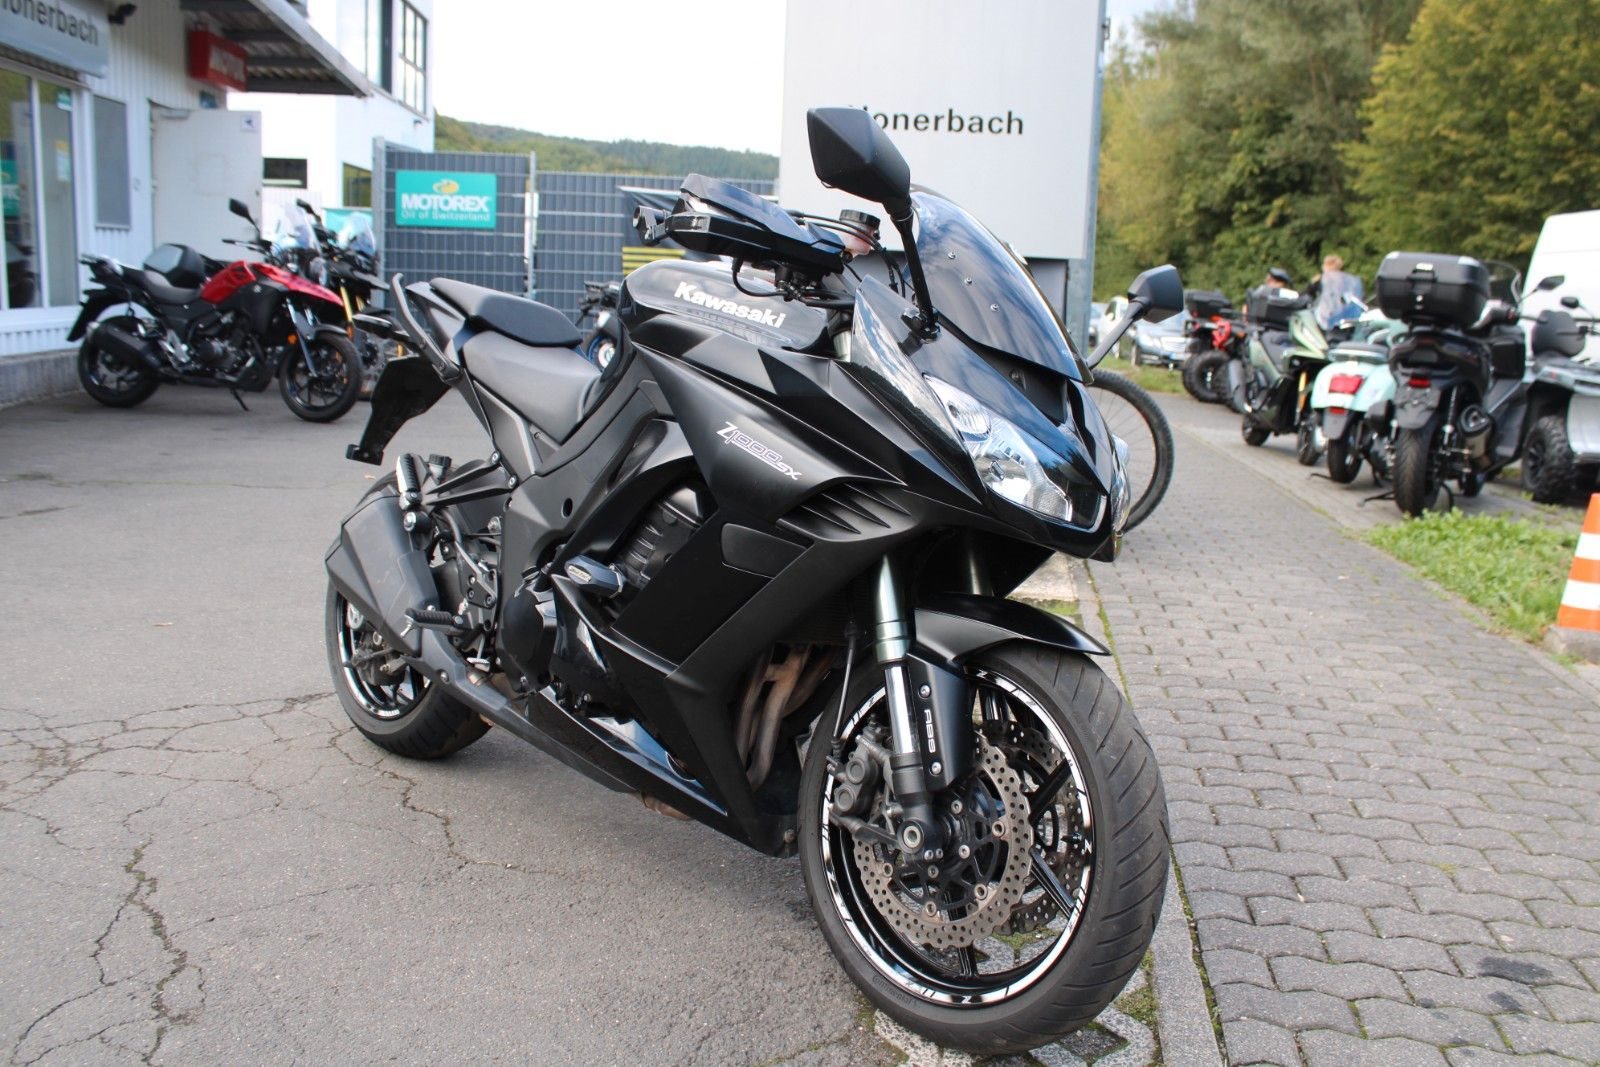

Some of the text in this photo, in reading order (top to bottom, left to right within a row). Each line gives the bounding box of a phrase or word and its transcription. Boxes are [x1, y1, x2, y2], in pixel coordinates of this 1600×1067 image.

[848, 105, 1023, 135] onerbach
[401, 193, 490, 213] MOTOREX
[401, 210, 491, 221] Oil of Switzerland
[674, 281, 787, 329] Kawasaki
[923, 708, 937, 753] ABS
